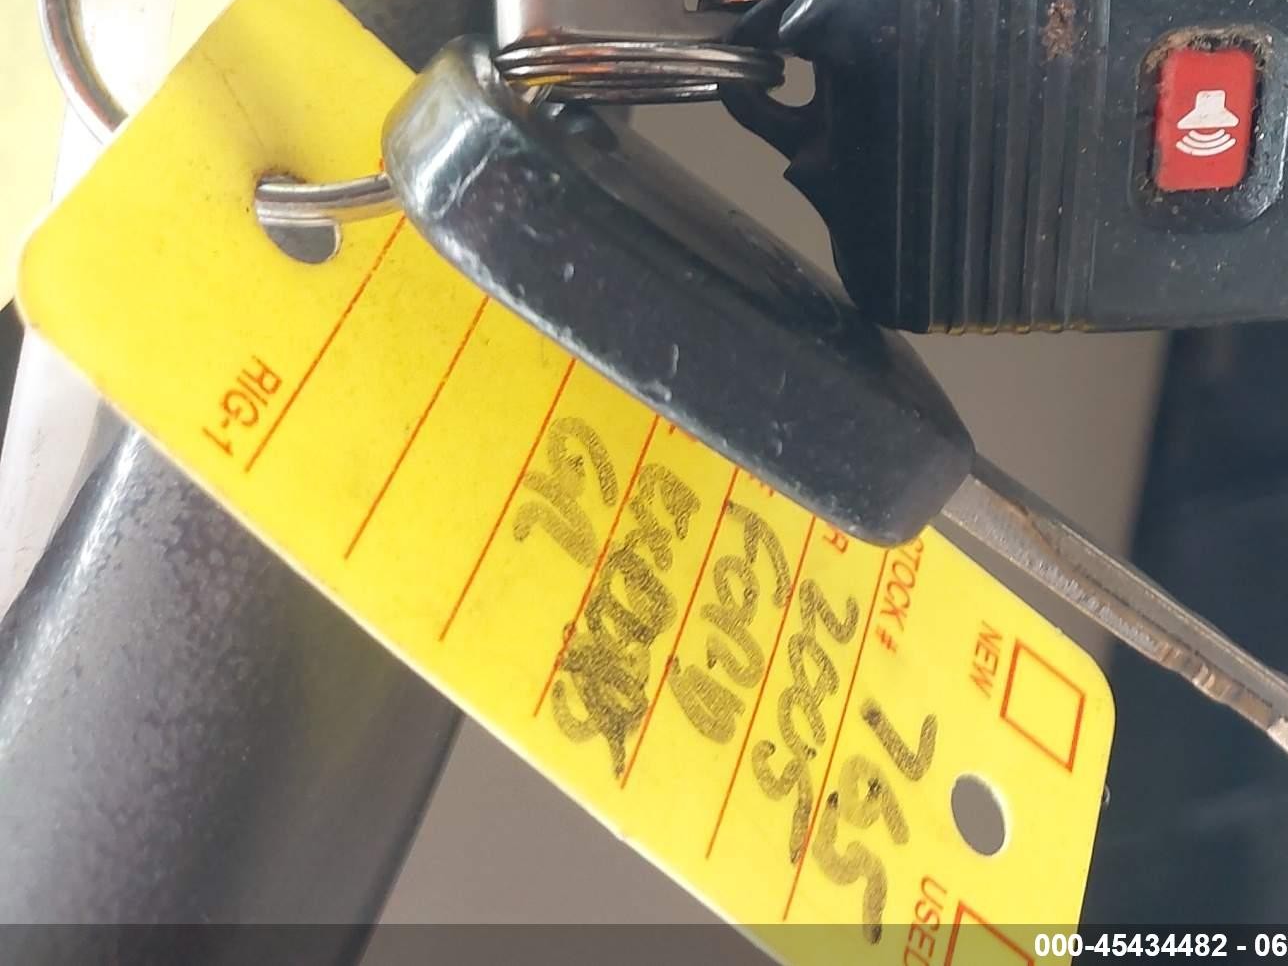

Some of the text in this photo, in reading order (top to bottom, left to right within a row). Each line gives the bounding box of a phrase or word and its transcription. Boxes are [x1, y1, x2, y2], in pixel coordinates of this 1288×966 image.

[201, 354, 281, 458] RIG-1
[875, 624, 899, 654] #
[969, 618, 1003, 700] NEW
[751, 577, 860, 866] 2005
[811, 697, 938, 945] 765
